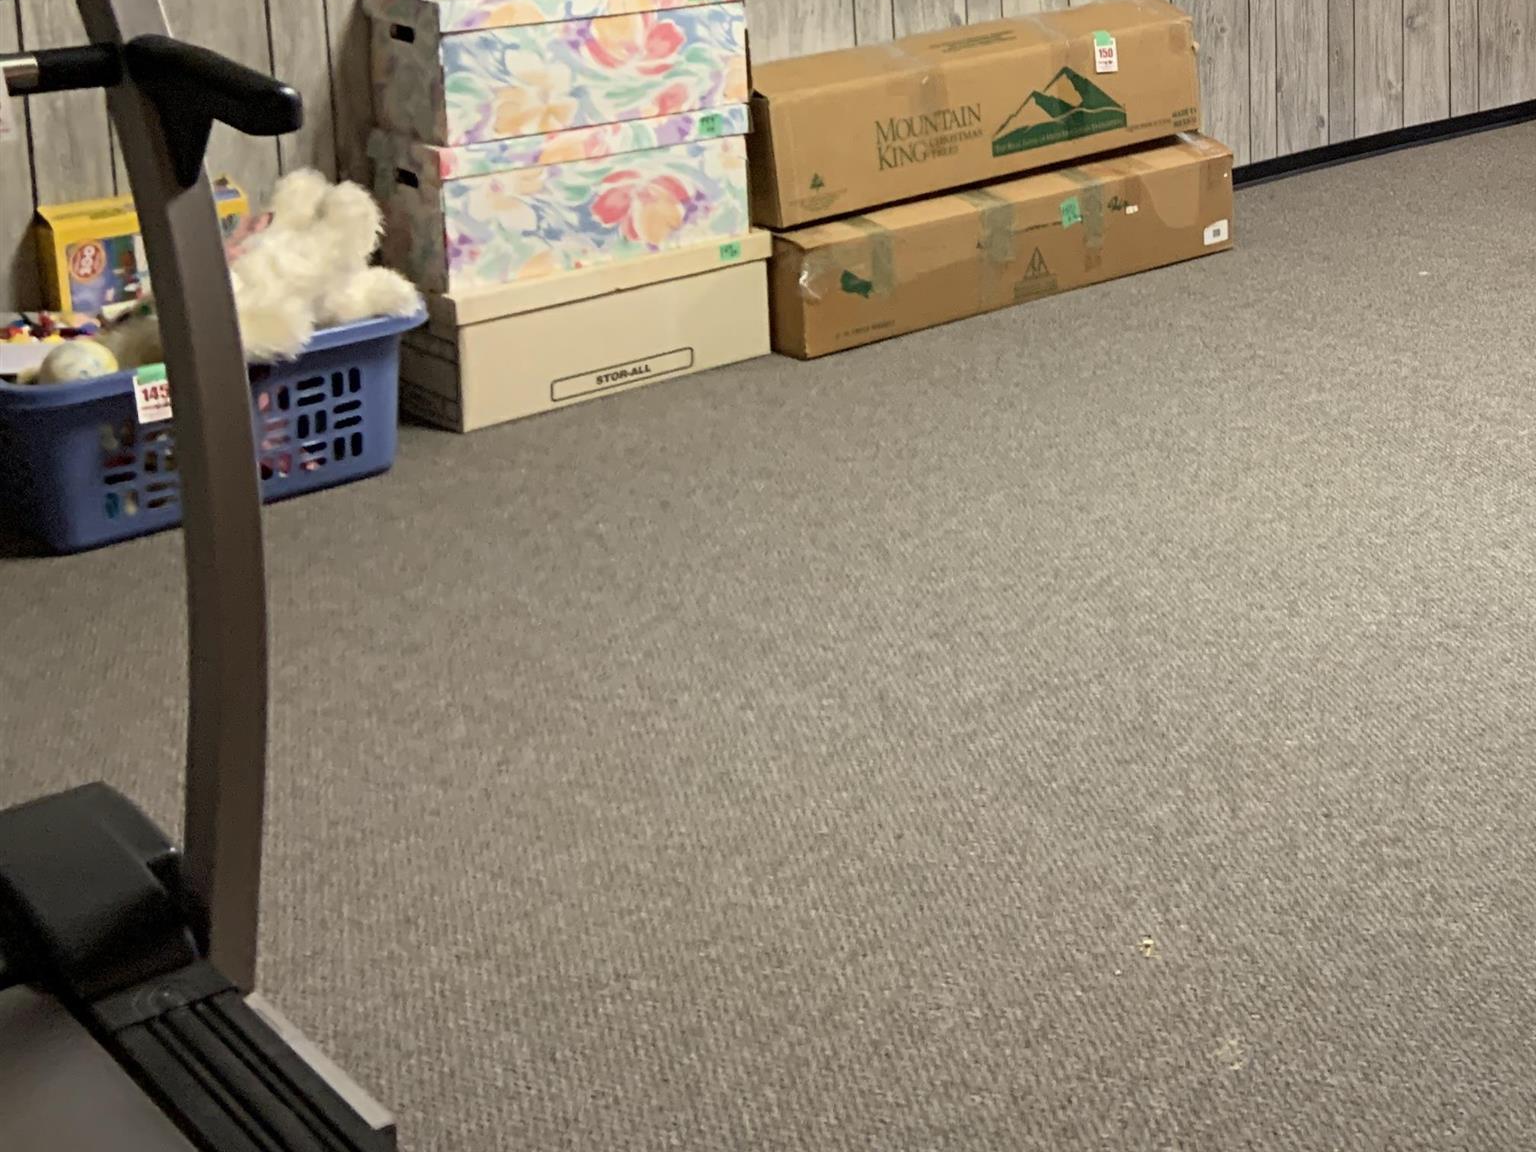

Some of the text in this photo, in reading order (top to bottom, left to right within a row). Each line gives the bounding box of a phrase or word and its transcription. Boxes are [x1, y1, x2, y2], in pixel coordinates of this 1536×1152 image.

[1098, 47, 1114, 59] 150
[874, 103, 982, 145] MOUNTAIN
[877, 141, 928, 171] KING
